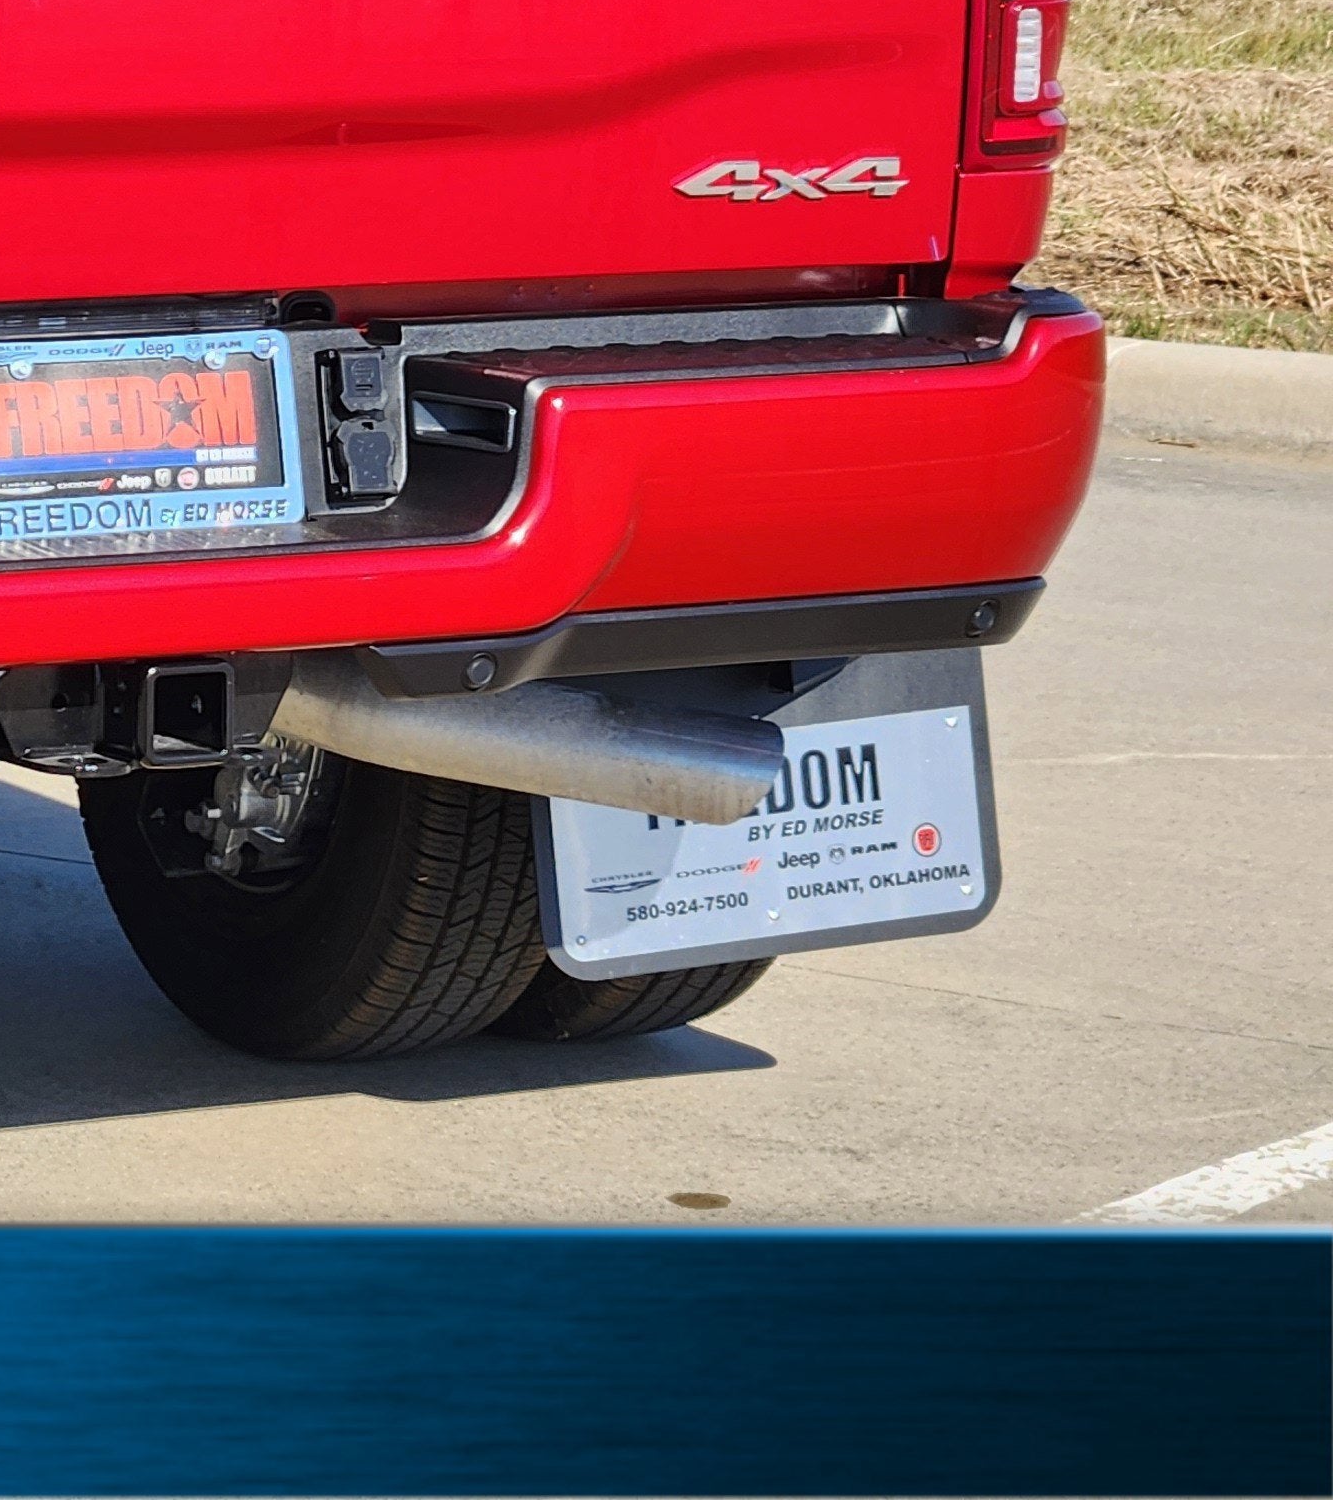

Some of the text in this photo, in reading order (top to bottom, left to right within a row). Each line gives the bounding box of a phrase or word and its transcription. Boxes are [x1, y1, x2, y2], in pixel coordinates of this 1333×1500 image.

[673, 157, 910, 200] 4x4
[135, 340, 174, 356] Jeep
[205, 340, 242, 350] RAM
[183, 503, 210, 522] ED
[747, 808, 885, 842] BY ED MORSE
[777, 851, 821, 869] Jeep
[850, 841, 898, 856] RAM
[787, 862, 971, 901] DURANT, OKLAHOMA
[626, 891, 750, 922] 580-924-7500
